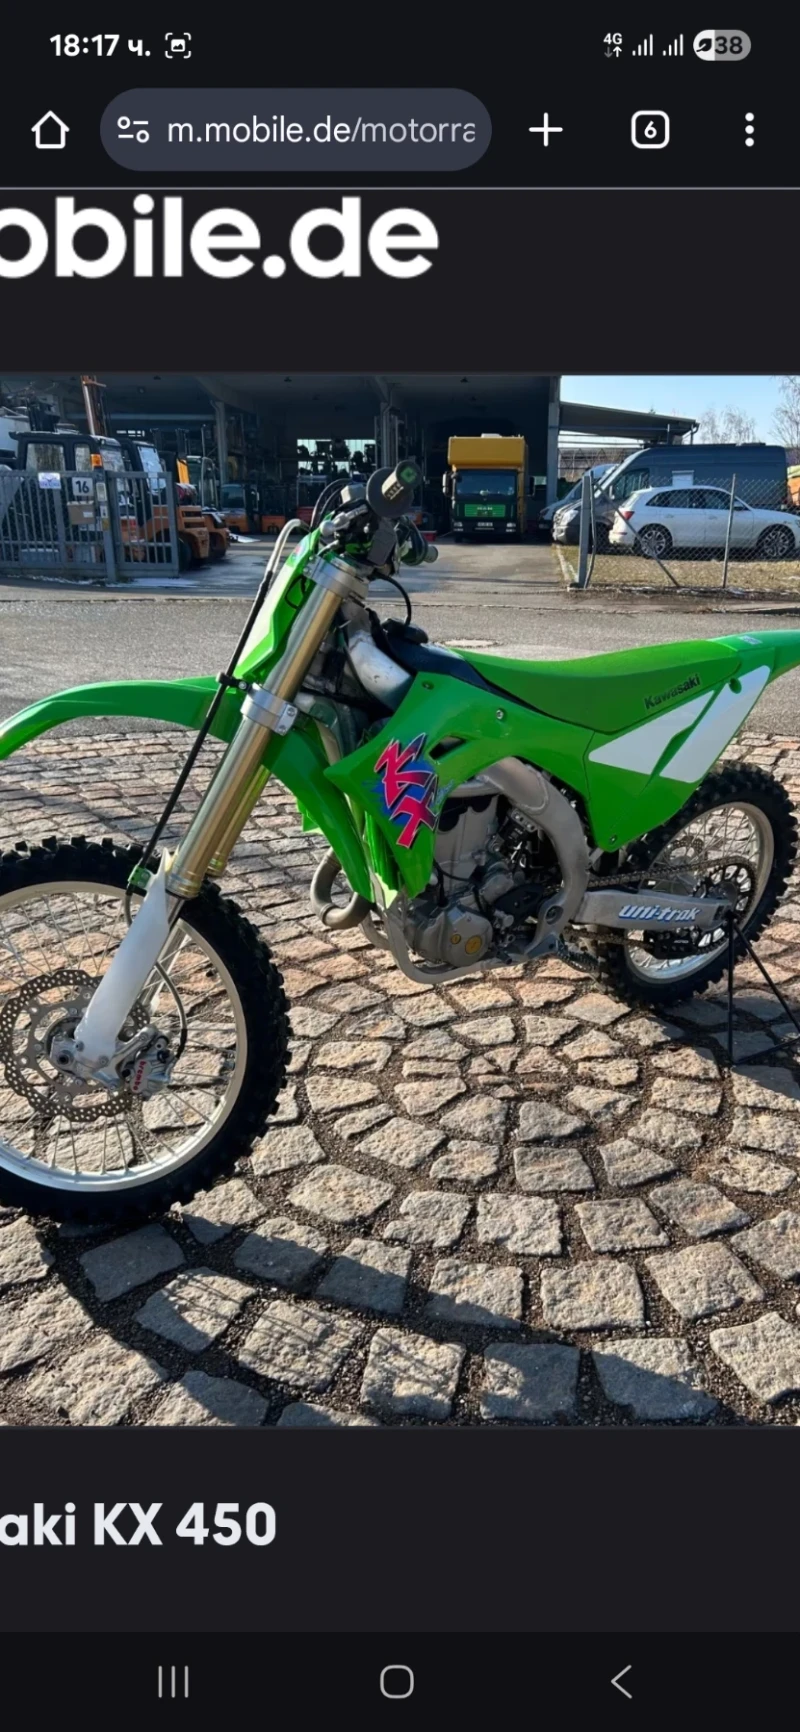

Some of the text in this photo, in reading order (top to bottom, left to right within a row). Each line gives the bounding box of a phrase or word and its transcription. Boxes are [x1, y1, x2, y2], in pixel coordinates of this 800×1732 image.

[50, 33, 151, 57] 18:17 ч.
[603, 32, 623, 45] 4G
[714, 36, 743, 54] 38
[168, 114, 476, 144] m.mobile.de/motorra
[644, 120, 657, 139] 6
[0, 194, 439, 279] obile.de
[75, 480, 90, 494] 16
[643, 673, 701, 710] Kawasaki
[373, 731, 439, 849] KX
[618, 904, 701, 922] uni-trak
[132, 1060, 147, 1091] brembo
[0, 1501, 276, 1546] aki KX 450
